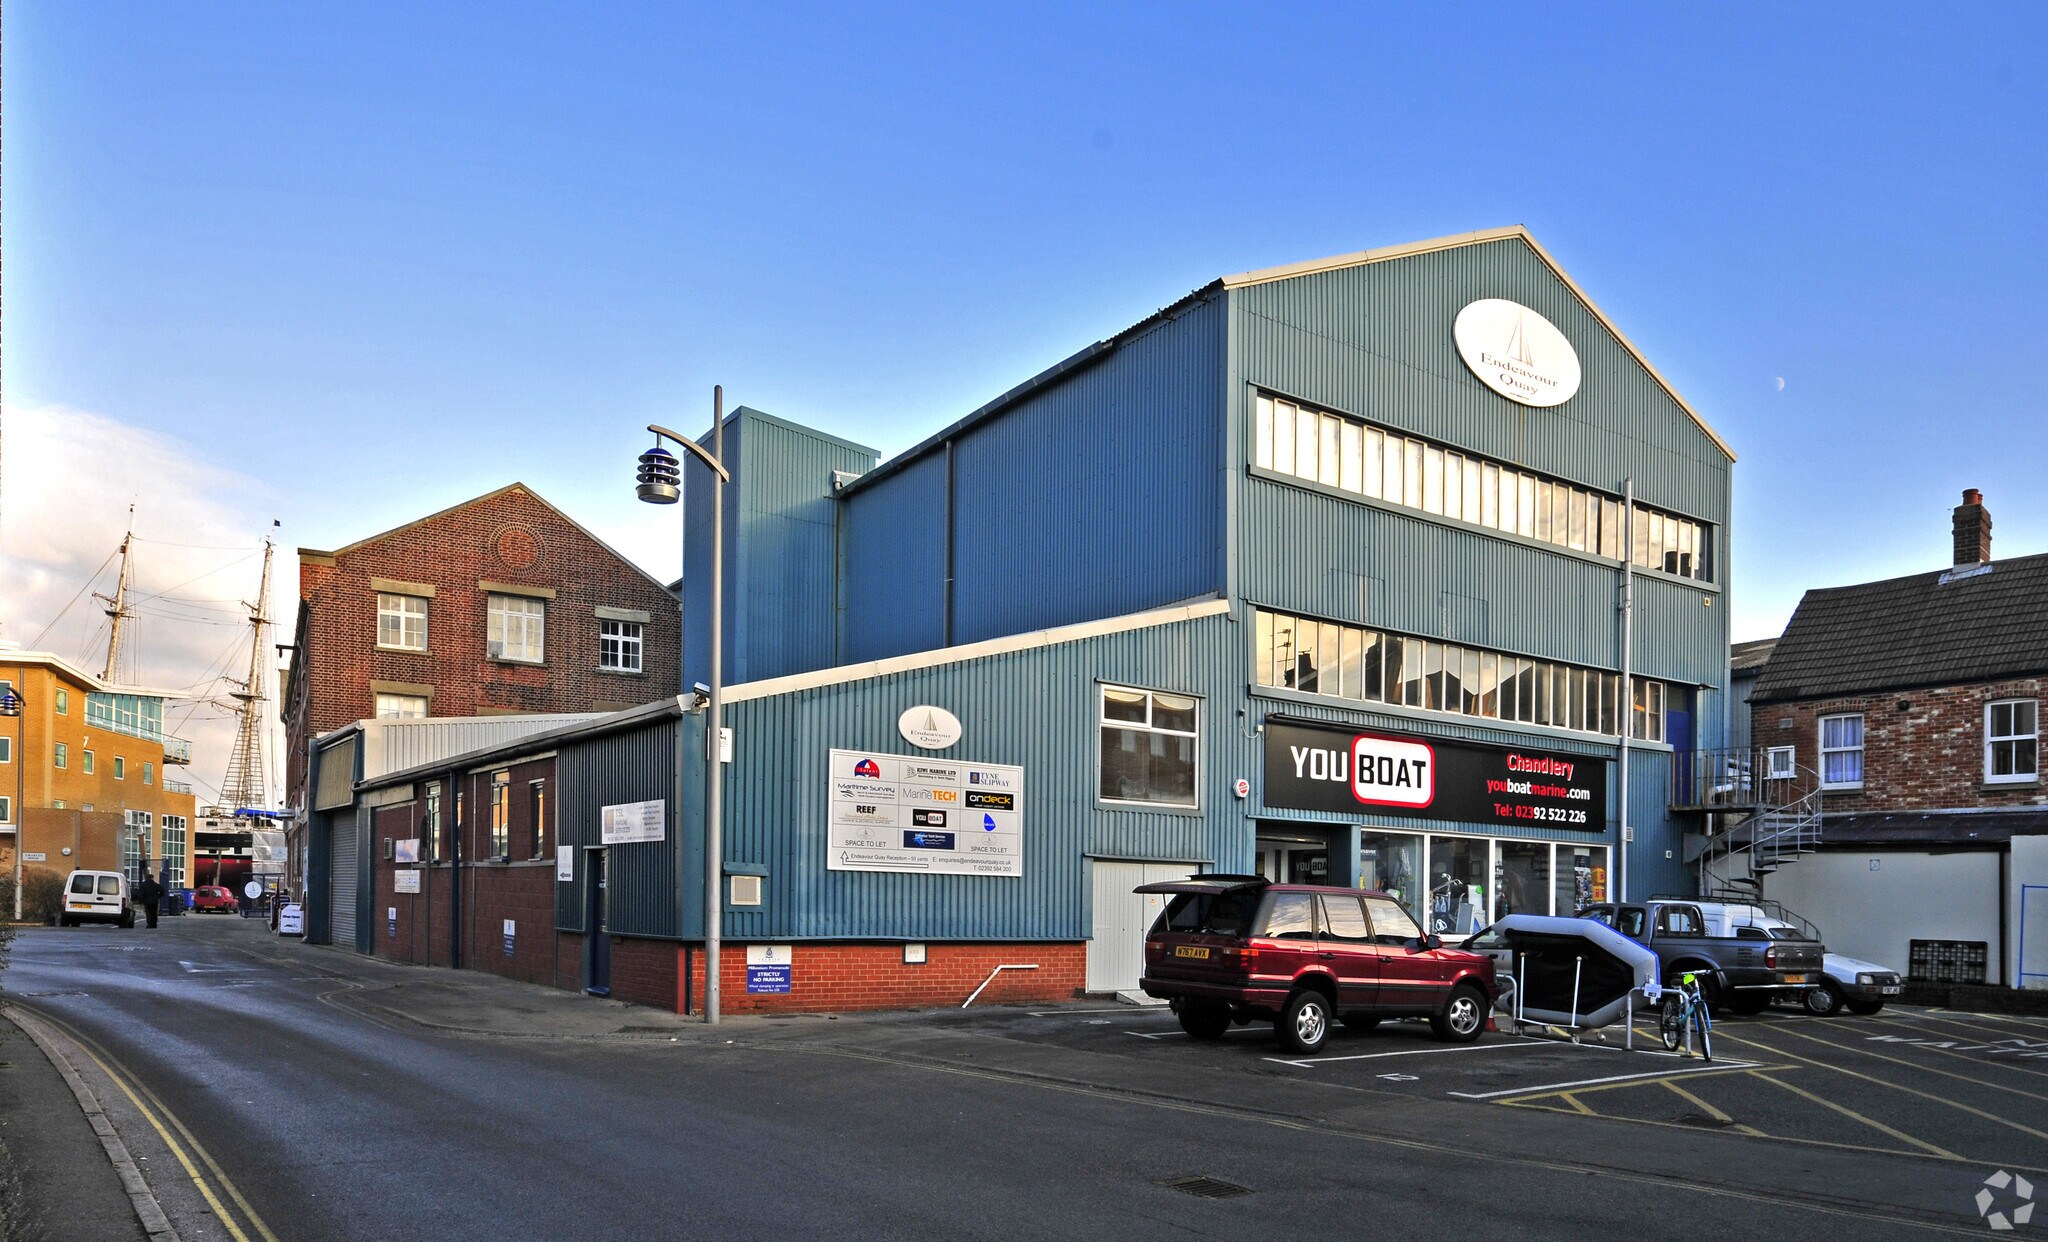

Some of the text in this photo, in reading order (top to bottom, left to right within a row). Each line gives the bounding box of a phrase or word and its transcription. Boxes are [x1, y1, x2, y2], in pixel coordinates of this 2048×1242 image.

[1481, 352, 1559, 387] Endeavour
[1500, 373, 1538, 395] Quay
[911, 730, 951, 738] Endeavour
[1290, 745, 1426, 788] YOU BOAT
[1507, 753, 1574, 781] Chandlery
[981, 772, 999, 780] TYNE
[838, 783, 895, 793] Maritime Survey
[980, 779, 1009, 787] SLIPWAY
[1487, 778, 1590, 800] youboatmarine.com
[969, 795, 1011, 804] ondeck
[856, 805, 877, 814] REEF
[1494, 803, 1586, 823] Tel: 02392 522 226
[1296, 861, 1327, 871] YOU BOA
